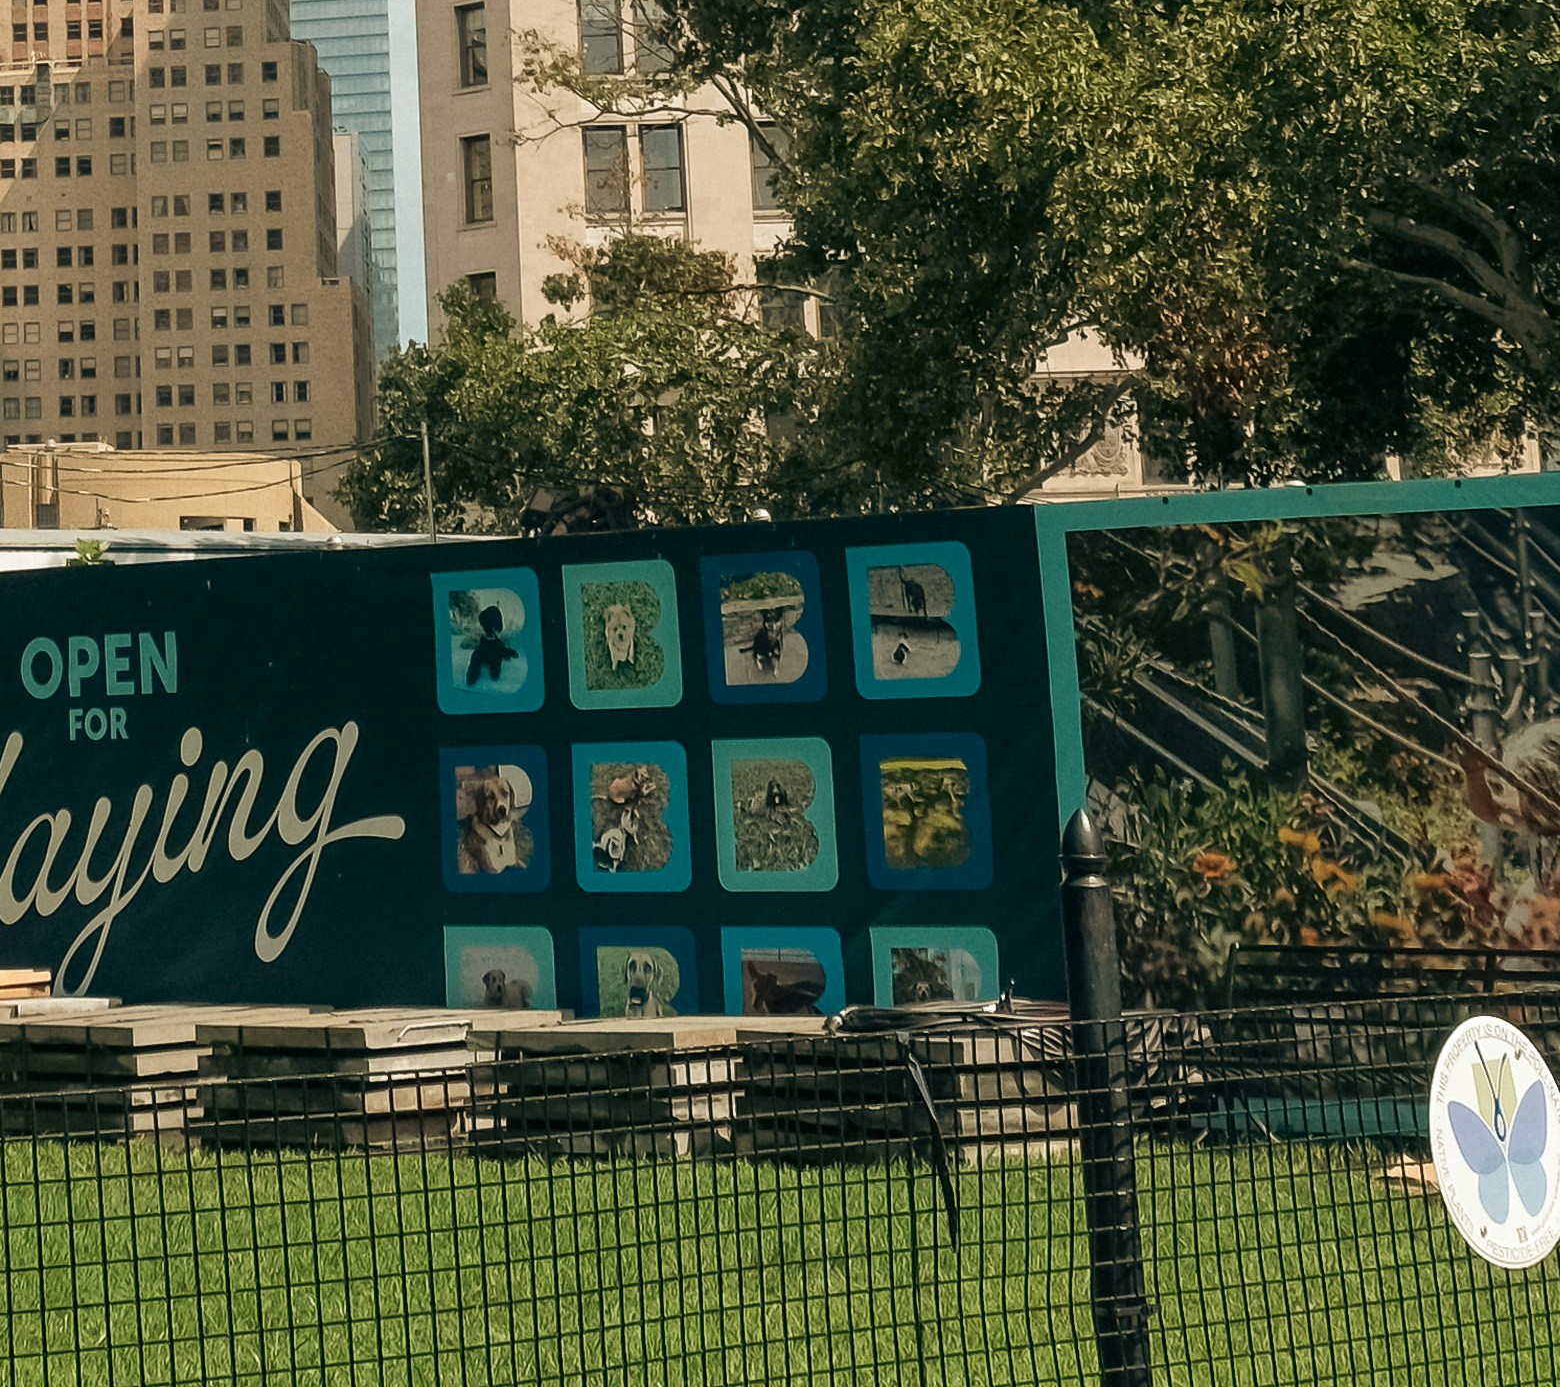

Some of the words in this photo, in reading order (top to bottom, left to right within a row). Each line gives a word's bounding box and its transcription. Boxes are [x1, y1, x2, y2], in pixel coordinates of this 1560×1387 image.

[21, 630, 178, 700] OPEN
[68, 707, 129, 741] FOR
[1436, 1072, 1449, 1103] THIS
[1444, 1025, 1482, 1073] PROPERTY
[1483, 1023, 1493, 1036] IS
[1494, 1025, 1508, 1042] ON
[1510, 1031, 1529, 1056] THE
[1436, 1129, 1451, 1180] NATIVE
